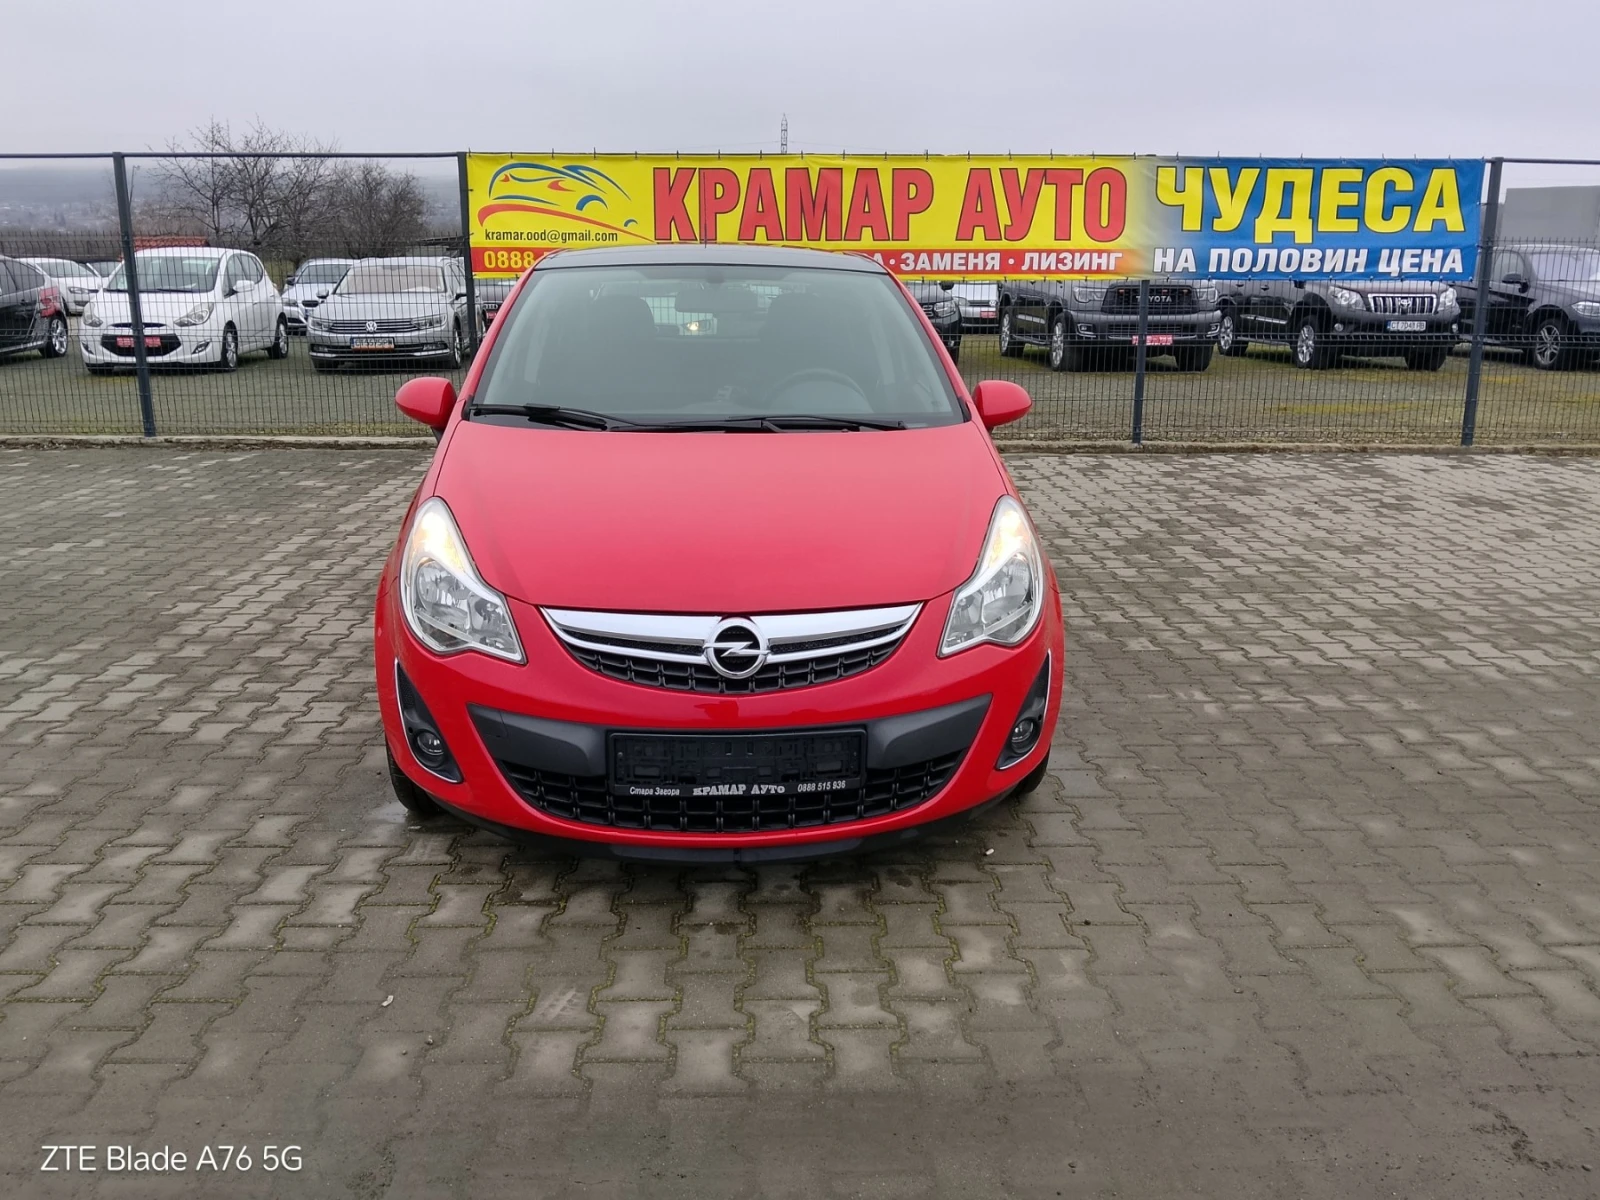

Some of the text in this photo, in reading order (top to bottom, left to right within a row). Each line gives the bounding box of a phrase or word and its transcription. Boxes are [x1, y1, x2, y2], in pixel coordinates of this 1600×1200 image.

[653, 166, 1127, 242] КРАМАР АУТО
[1155, 166, 1465, 244] ЧУДЕСА
[485, 229, 618, 243] kramar.ood@gmail.com
[483, 250, 535, 269] 0888
[900, 252, 1000, 271] ЗАМЕНЯ
[1021, 252, 1123, 271] ЛИЗИНГ
[1153, 248, 1464, 277] НА ПОЛОВИН ЦЕНА
[693, 784, 746, 796] КРАМАР
[797, 783, 816, 793] 0888
[817, 781, 831, 791] 515
